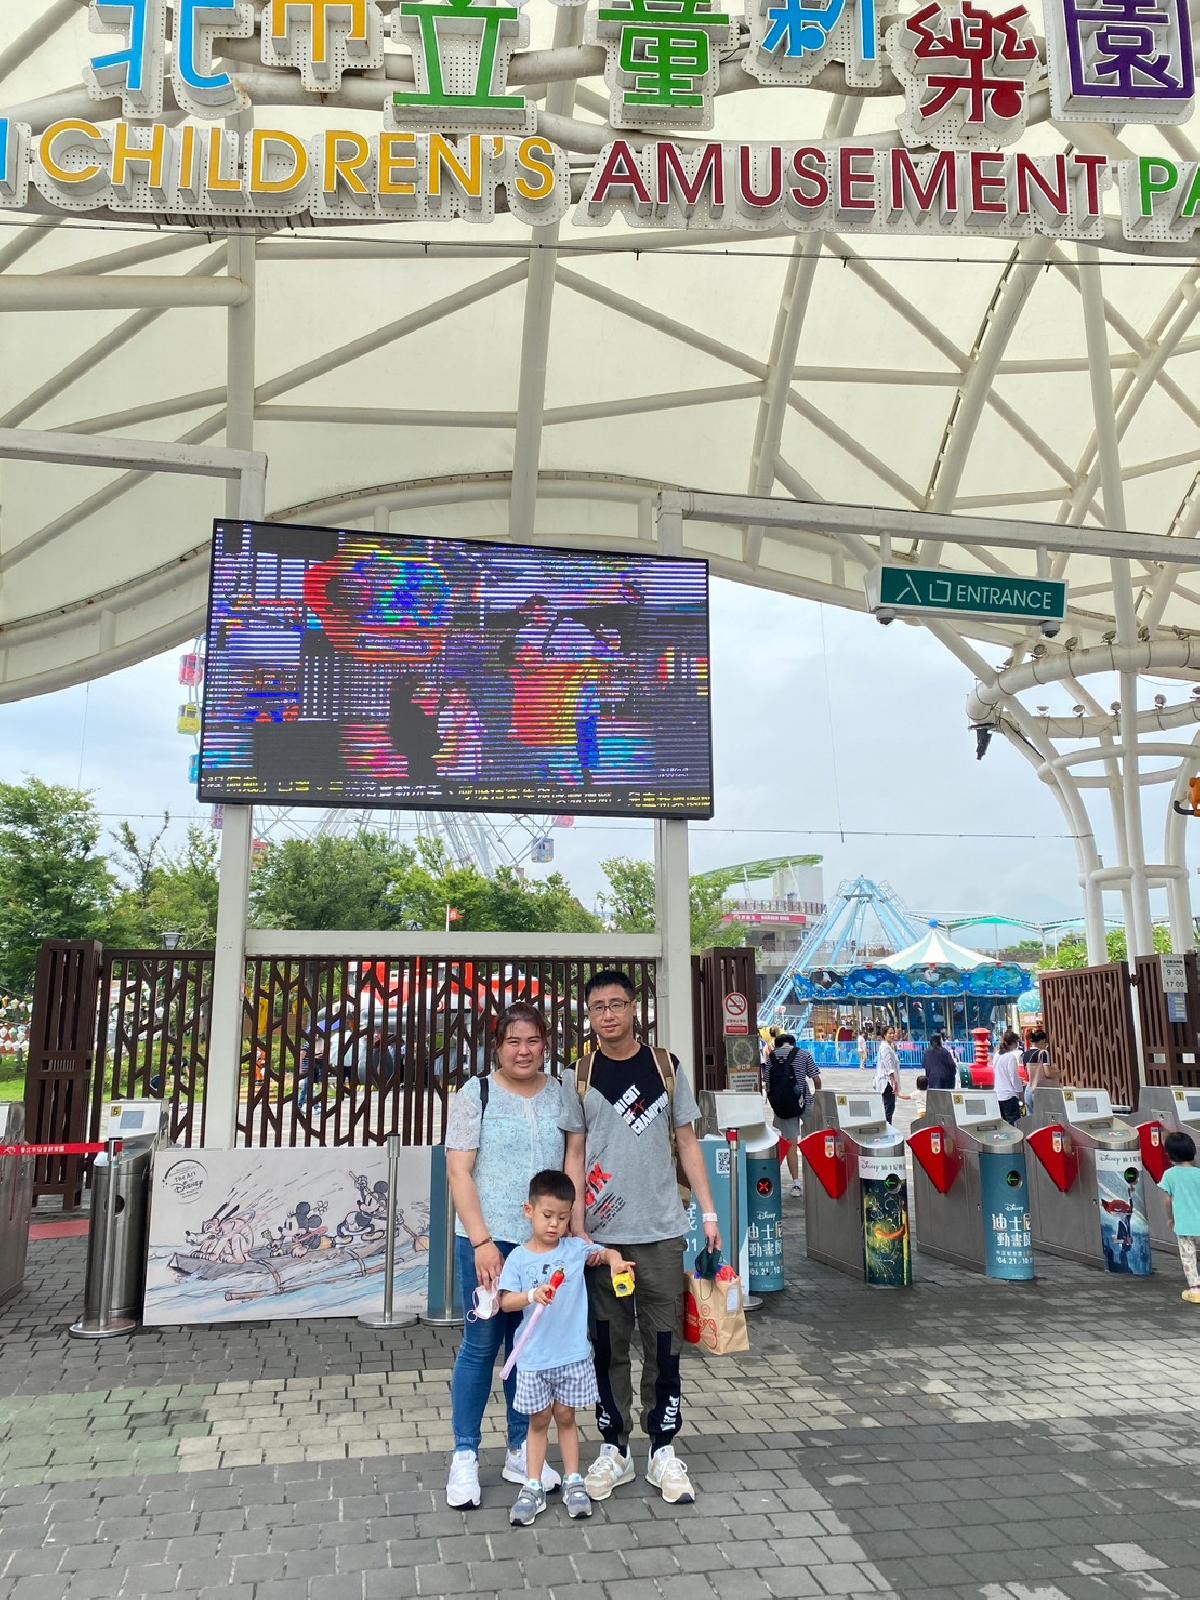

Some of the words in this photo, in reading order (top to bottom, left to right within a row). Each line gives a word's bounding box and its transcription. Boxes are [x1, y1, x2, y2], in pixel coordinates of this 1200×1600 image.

[39, 118, 556, 200] CHILDREN'S
[594, 140, 1108, 215] AMUSEMENT
[896, 573, 952, 603] 入口
[956, 584, 1053, 610] ENTRANCE
